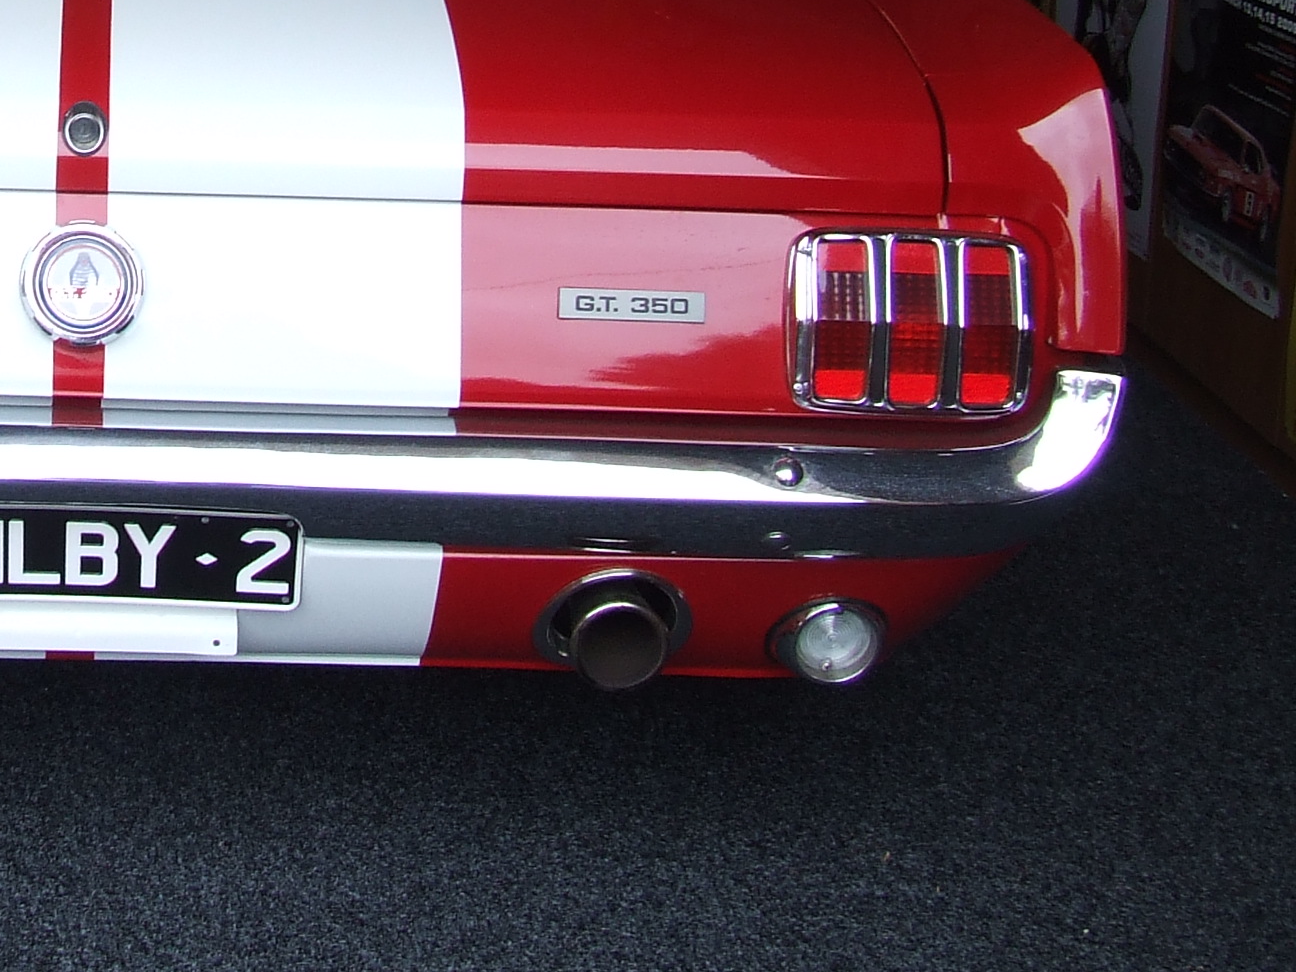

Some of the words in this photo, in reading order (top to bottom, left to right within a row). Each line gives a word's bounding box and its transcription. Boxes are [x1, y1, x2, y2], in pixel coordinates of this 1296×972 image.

[575, 295, 619, 312] G.T.
[630, 297, 689, 315] 350
[235, 529, 292, 594] 2
